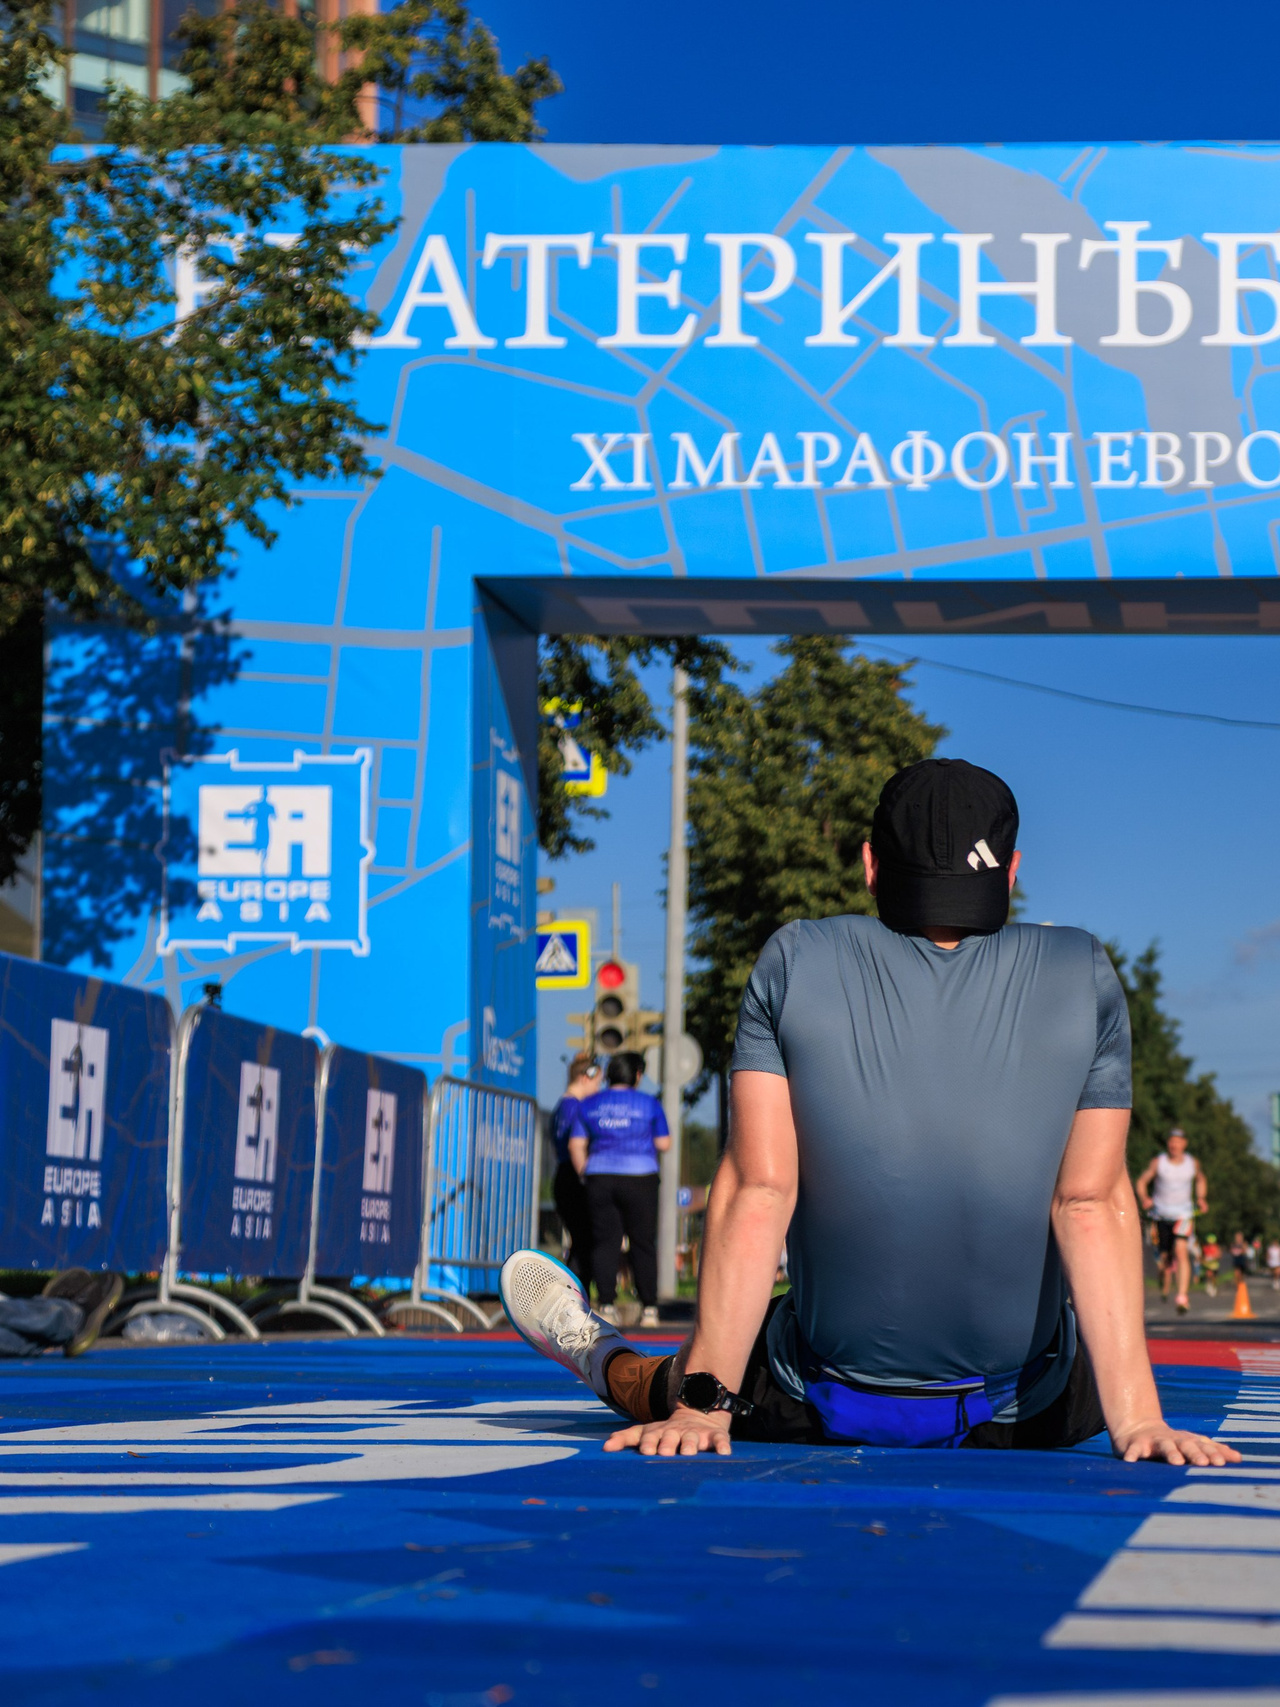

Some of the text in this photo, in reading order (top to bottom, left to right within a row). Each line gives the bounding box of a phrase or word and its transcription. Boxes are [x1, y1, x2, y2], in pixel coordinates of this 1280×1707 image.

[569, 431, 652, 491] XI
[669, 430, 1074, 491] МАРАФОН
[197, 879, 331, 902] EUROPE
[196, 901, 331, 923] ASIA
[43, 1166, 102, 1198] EUROPE
[41, 1199, 101, 1229] ASIA
[231, 1185, 273, 1214] EUROPE
[230, 1214, 273, 1240] ASIA
